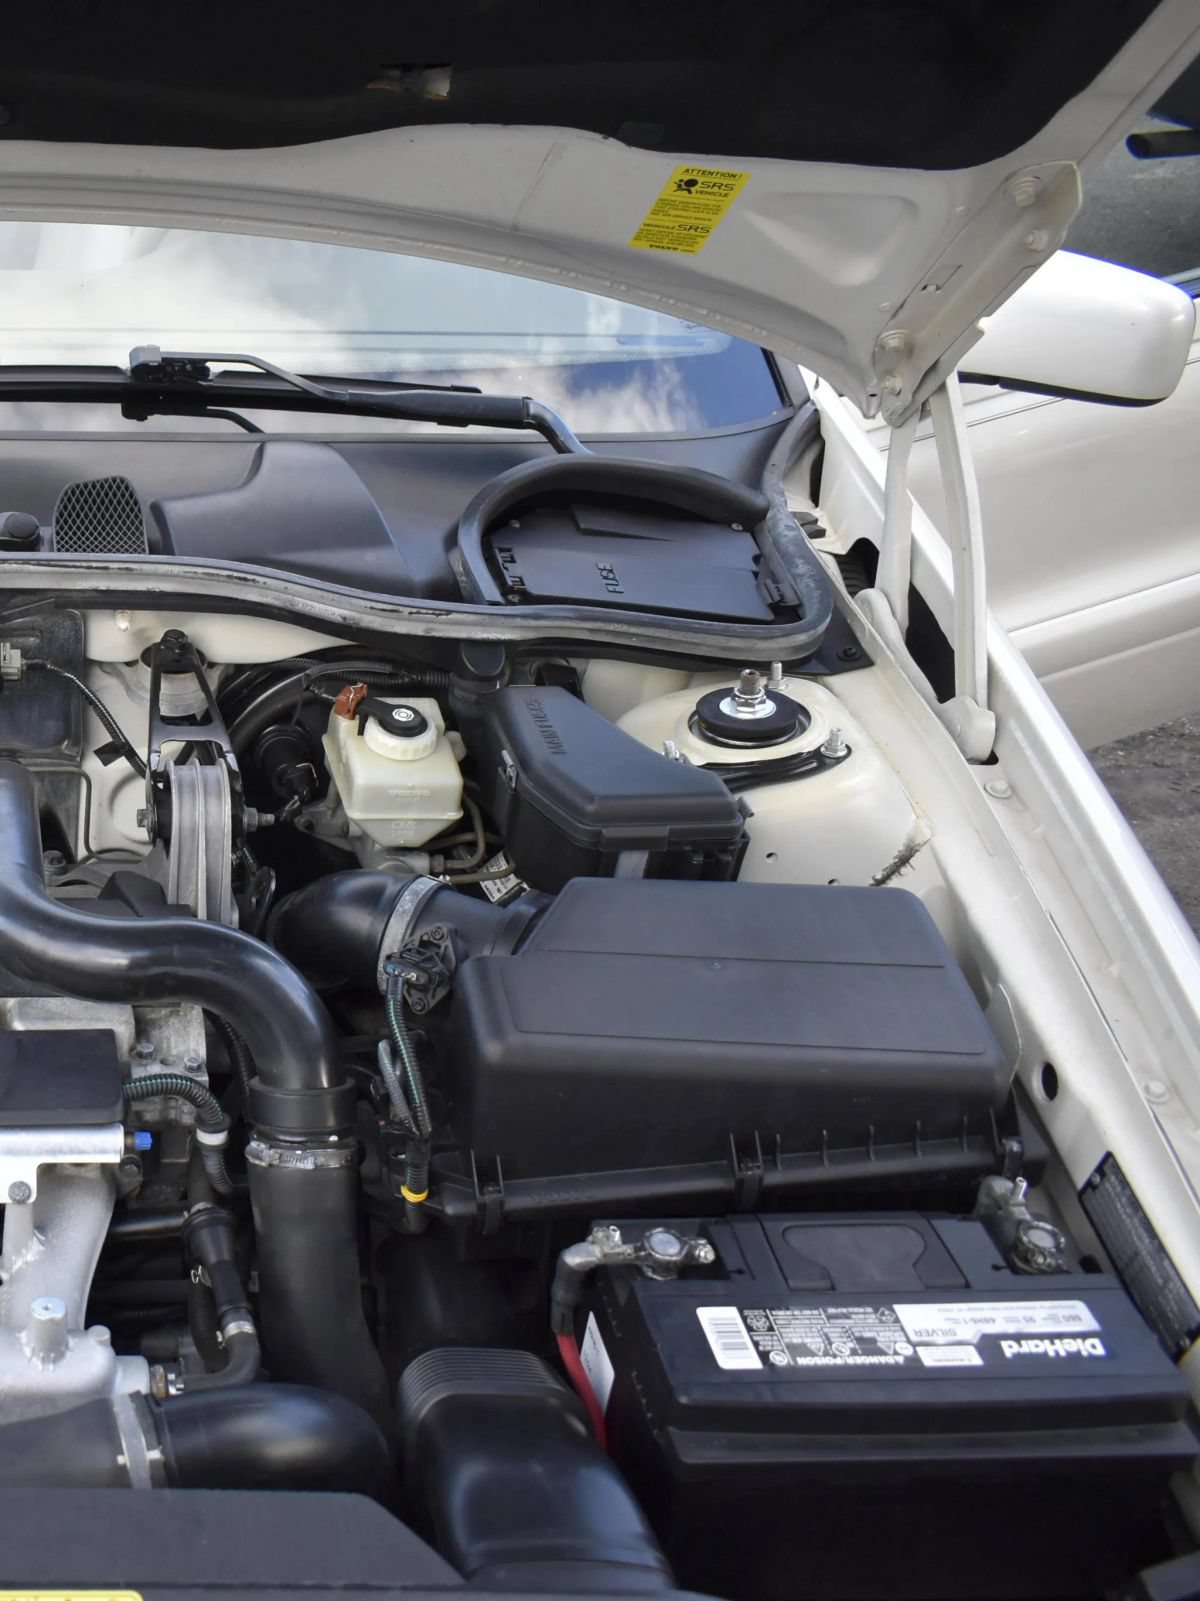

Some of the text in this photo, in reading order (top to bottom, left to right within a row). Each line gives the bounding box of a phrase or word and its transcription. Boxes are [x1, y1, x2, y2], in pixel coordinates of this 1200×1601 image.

[700, 181, 737, 192] SRS
[694, 189, 730, 198] VEHICLE
[676, 224, 713, 234] SRS
[595, 561, 625, 595] FUSE
[913, 1327, 959, 1340] SILVER
[1001, 1336, 1107, 1359] DieHard
